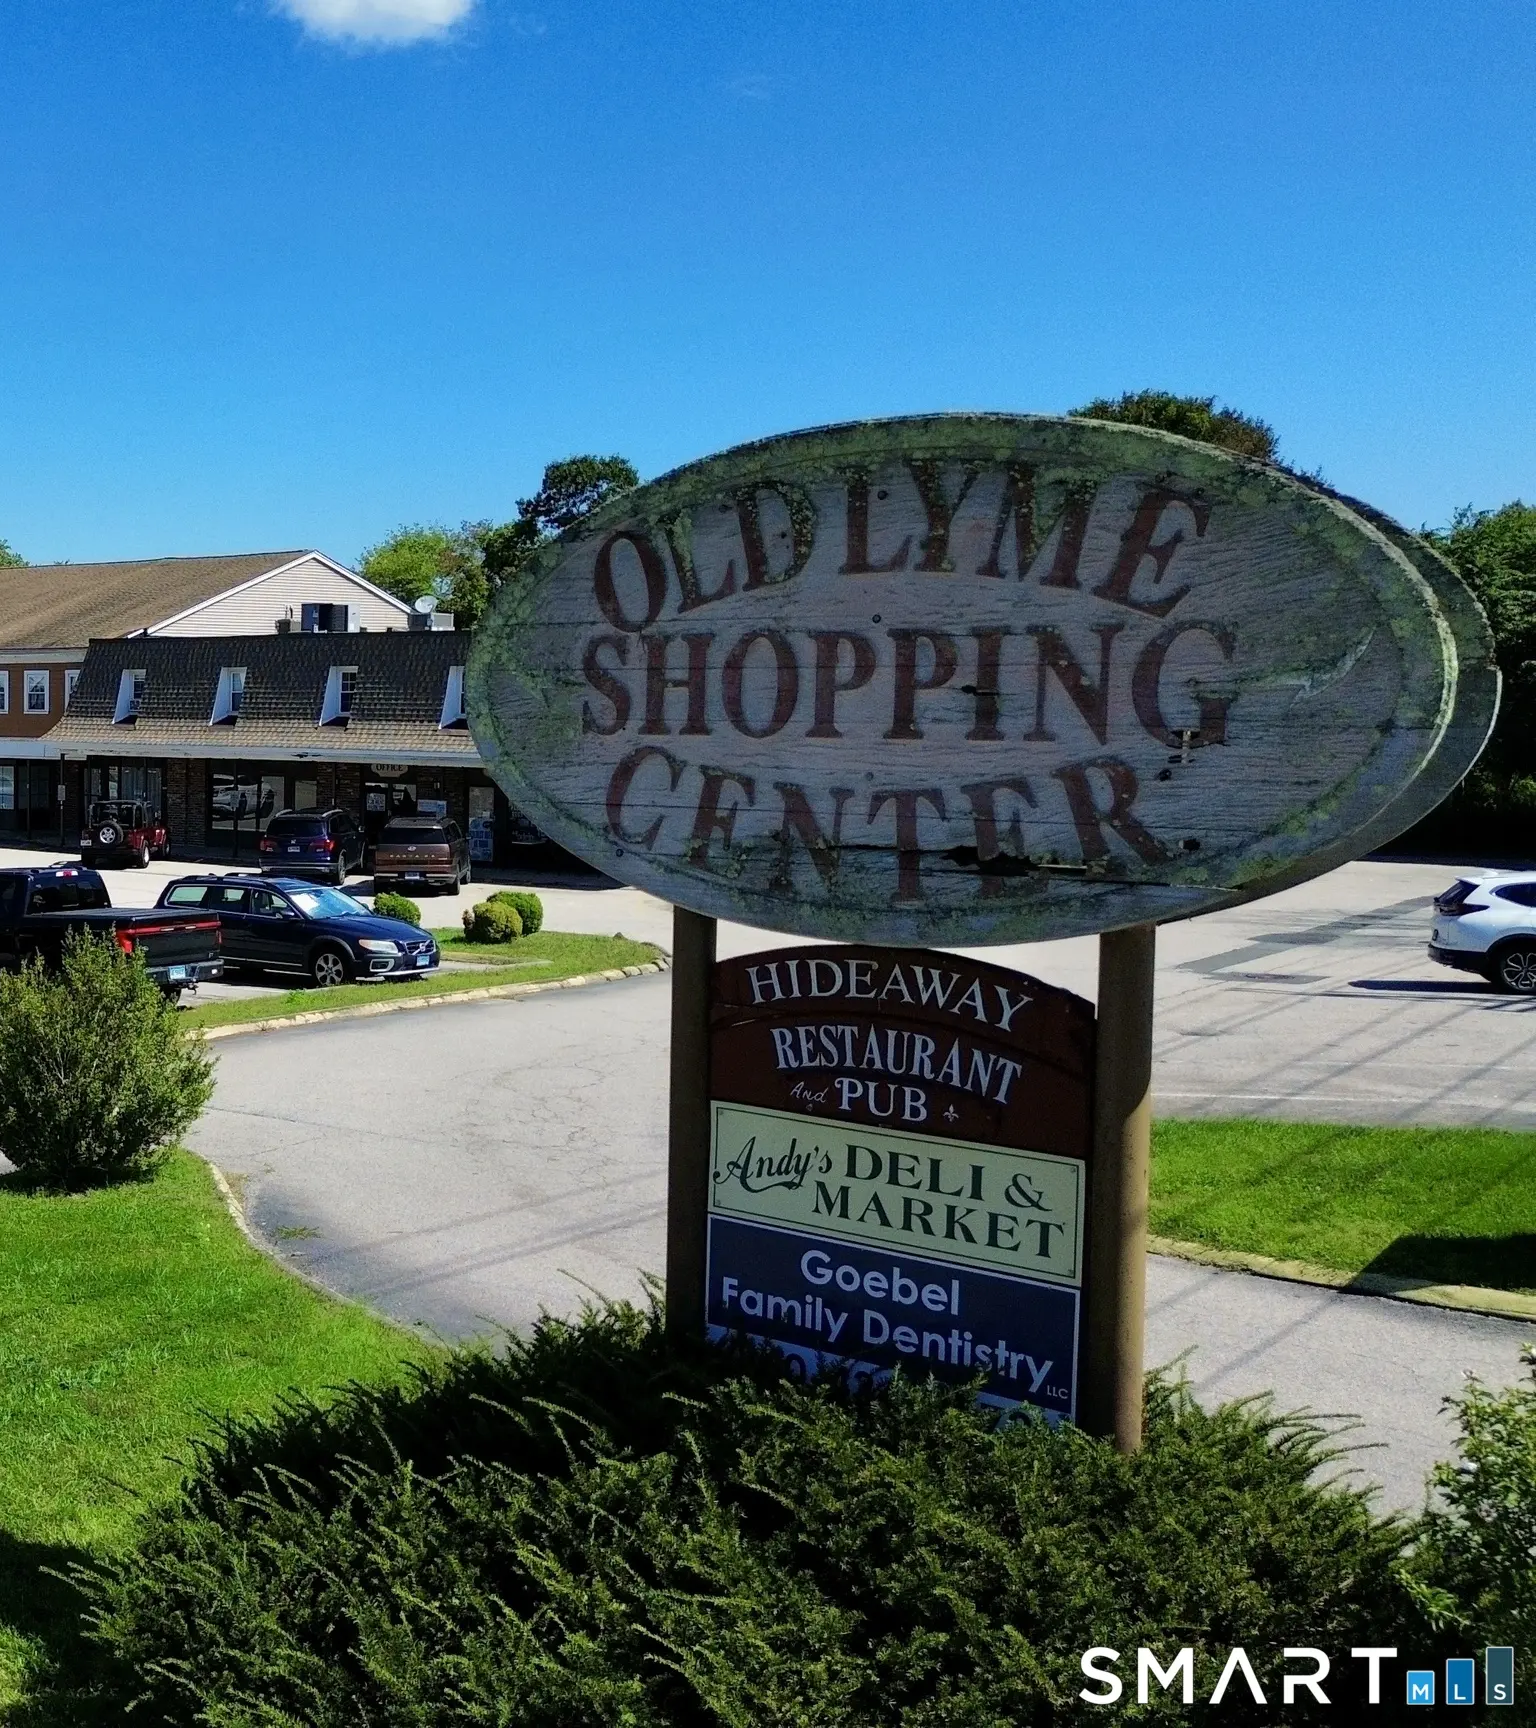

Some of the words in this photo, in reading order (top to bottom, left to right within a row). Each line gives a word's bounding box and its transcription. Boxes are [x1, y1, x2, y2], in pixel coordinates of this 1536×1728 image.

[593, 480, 817, 634] OLD
[840, 459, 1209, 617] LYME
[581, 621, 1238, 749] SHOPPING
[376, 763, 404, 772] OFFICE
[606, 745, 1174, 902] CENTER
[745, 958, 1033, 1033] HIDEAWAY
[770, 1023, 1023, 1105] RESTAURANT
[834, 1077, 928, 1123] PUB
[712, 1135, 833, 1194] Andy's
[844, 1142, 986, 1202] DELI
[1005, 1172, 1052, 1212] &
[812, 1179, 1066, 1259] MARKET
[800, 1249, 960, 1316] Goebel
[721, 1277, 848, 1343] Family
[863, 1309, 1054, 1394] Dentistry
[1046, 1386, 1069, 1401] LLC
